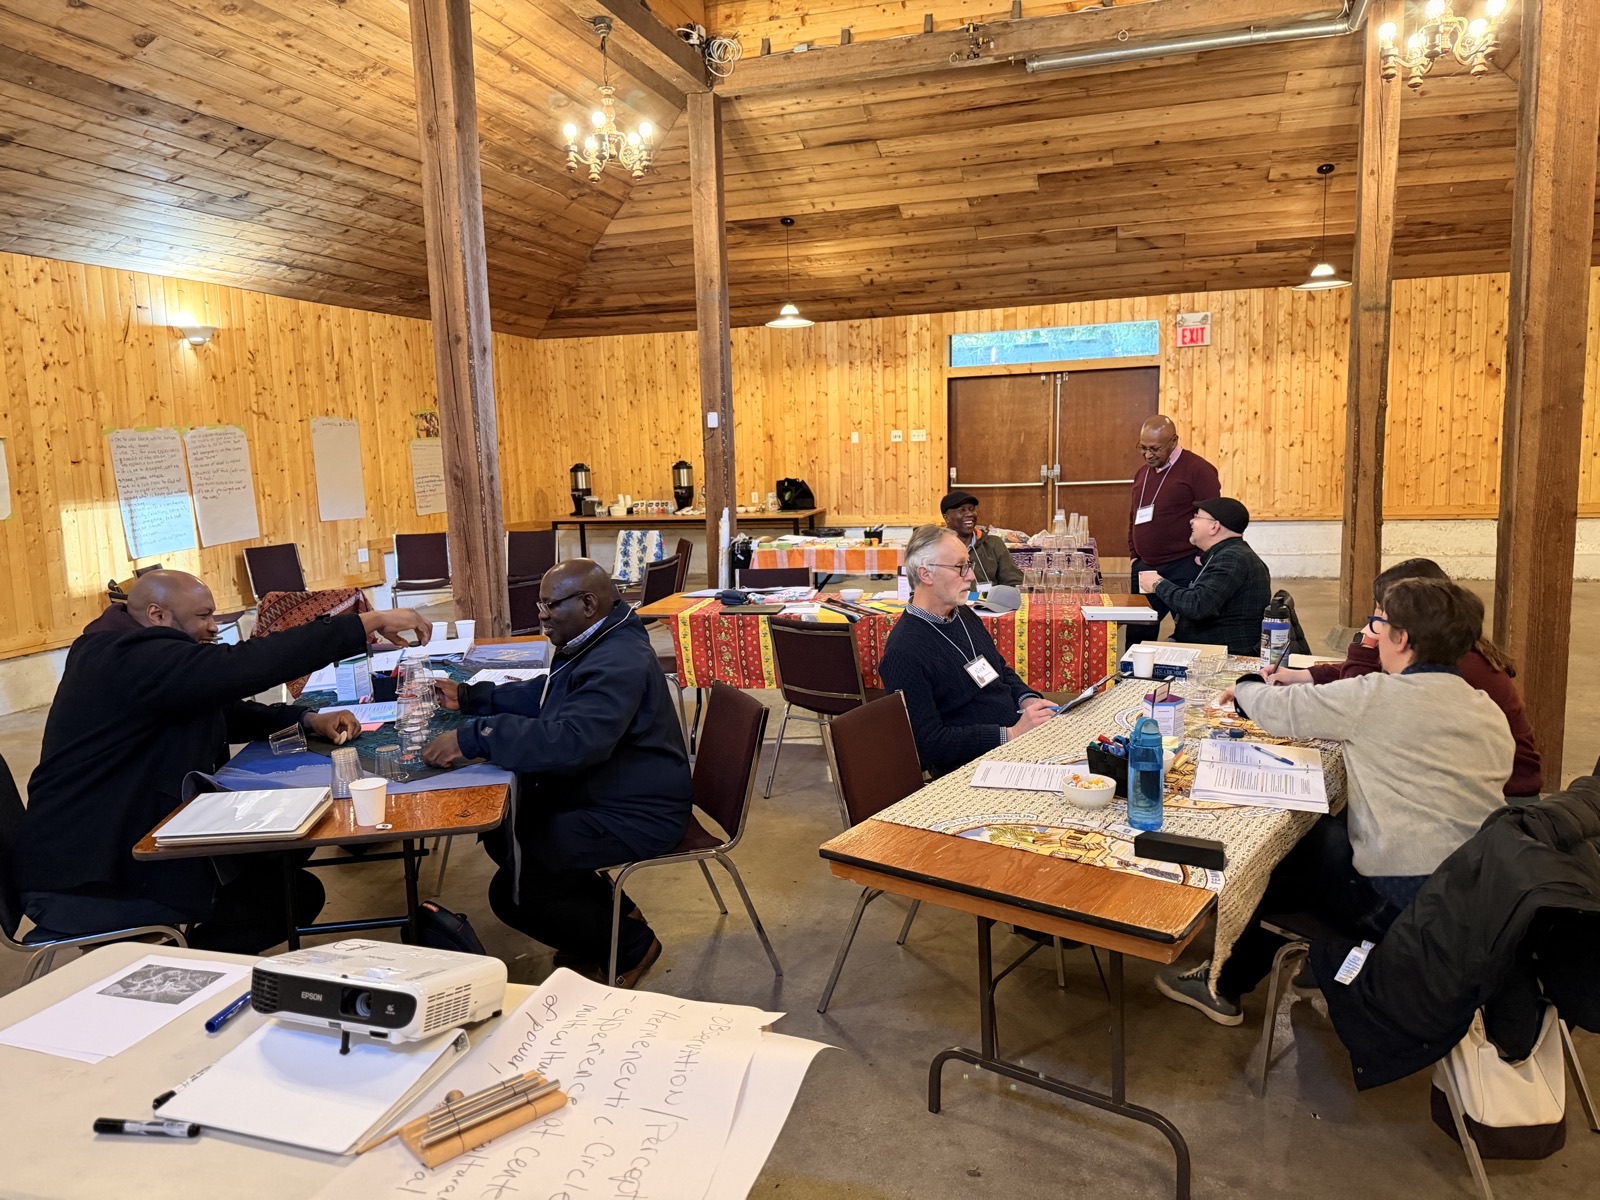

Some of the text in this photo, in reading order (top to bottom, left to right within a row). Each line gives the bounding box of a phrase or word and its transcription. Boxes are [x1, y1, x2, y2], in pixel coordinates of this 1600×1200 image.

[1181, 326, 1206, 345] EXIT
[300, 991, 323, 1002] EPSON
[507, 1011, 544, 1071] power
